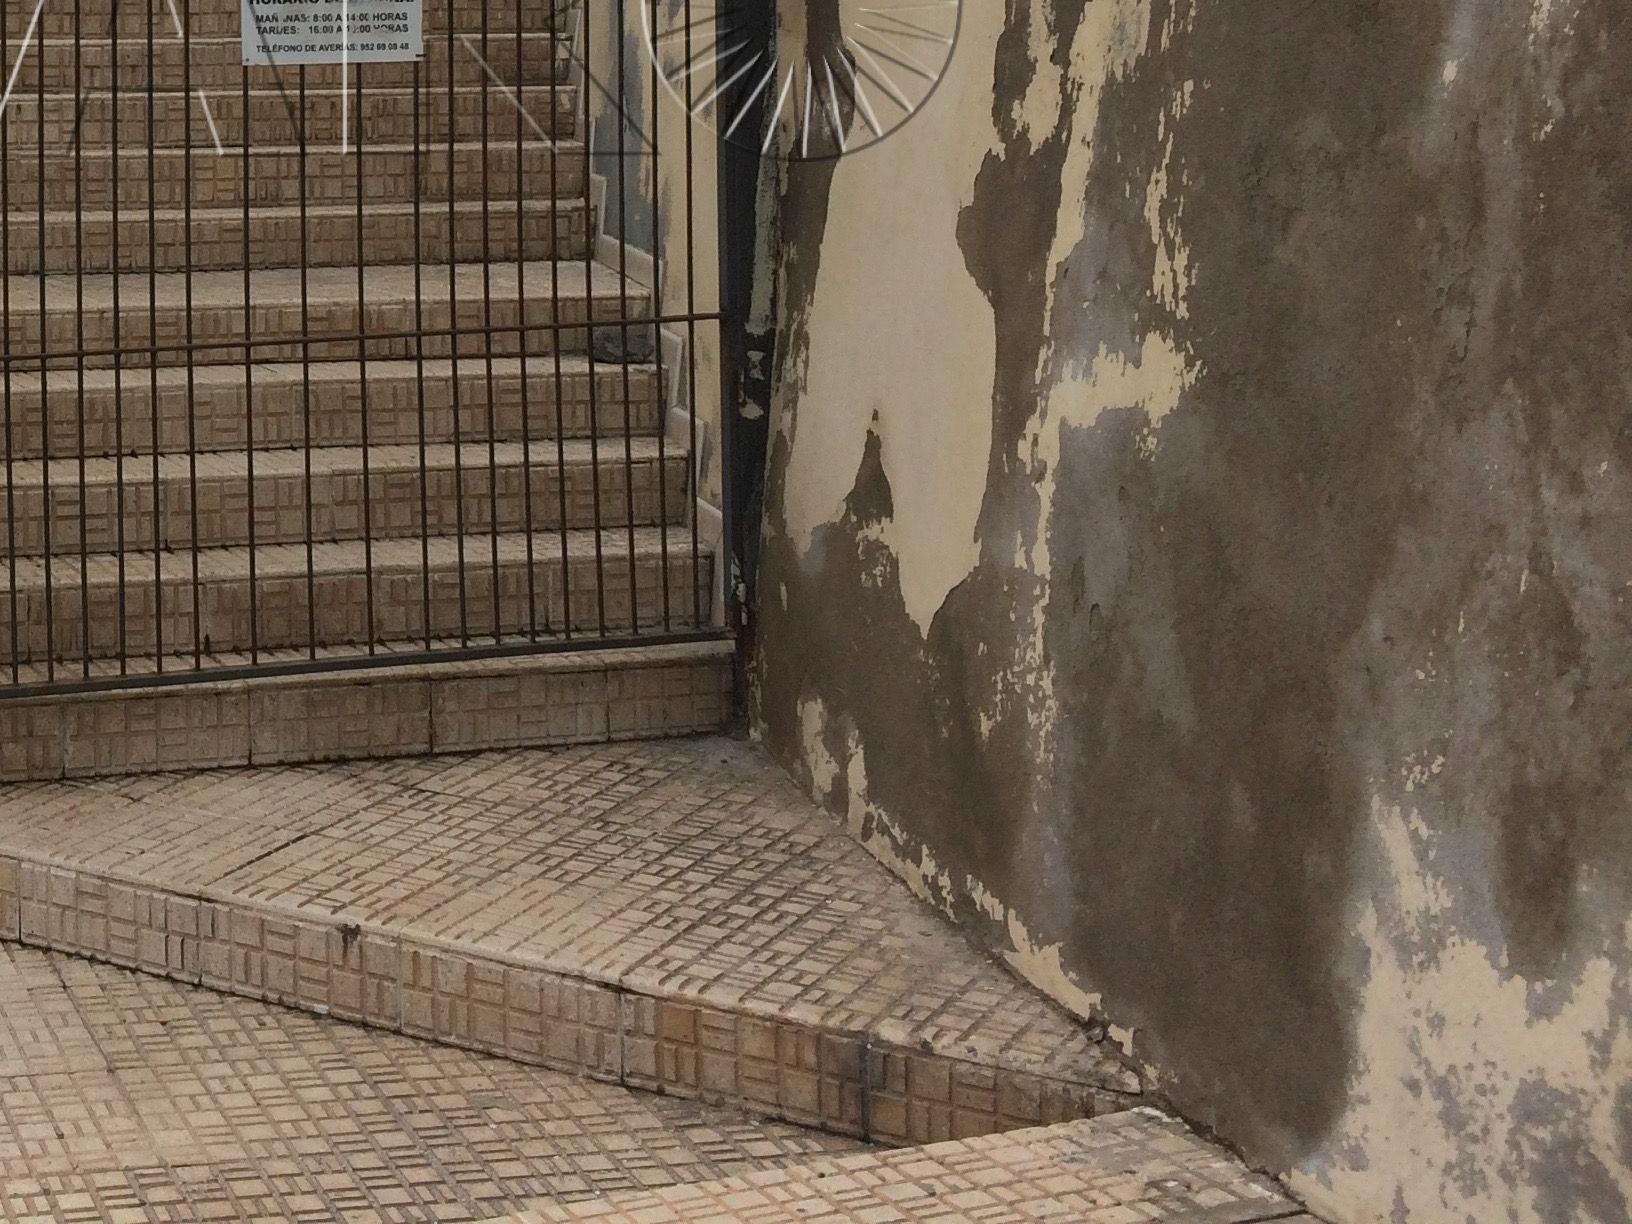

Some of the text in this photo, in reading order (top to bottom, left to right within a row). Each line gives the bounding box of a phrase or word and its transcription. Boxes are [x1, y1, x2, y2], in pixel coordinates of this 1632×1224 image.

[255, 13, 311, 23] MAÑNAS:
[313, 13, 333, 23] 8:00
[335, 13, 343, 22] A
[373, 12, 408, 21] HORAS
[336, 24, 343, 33] A
[347, 24, 371, 34] 1:00
[256, 43, 303, 53] TELÉFONO
[304, 43, 317, 52] DE
